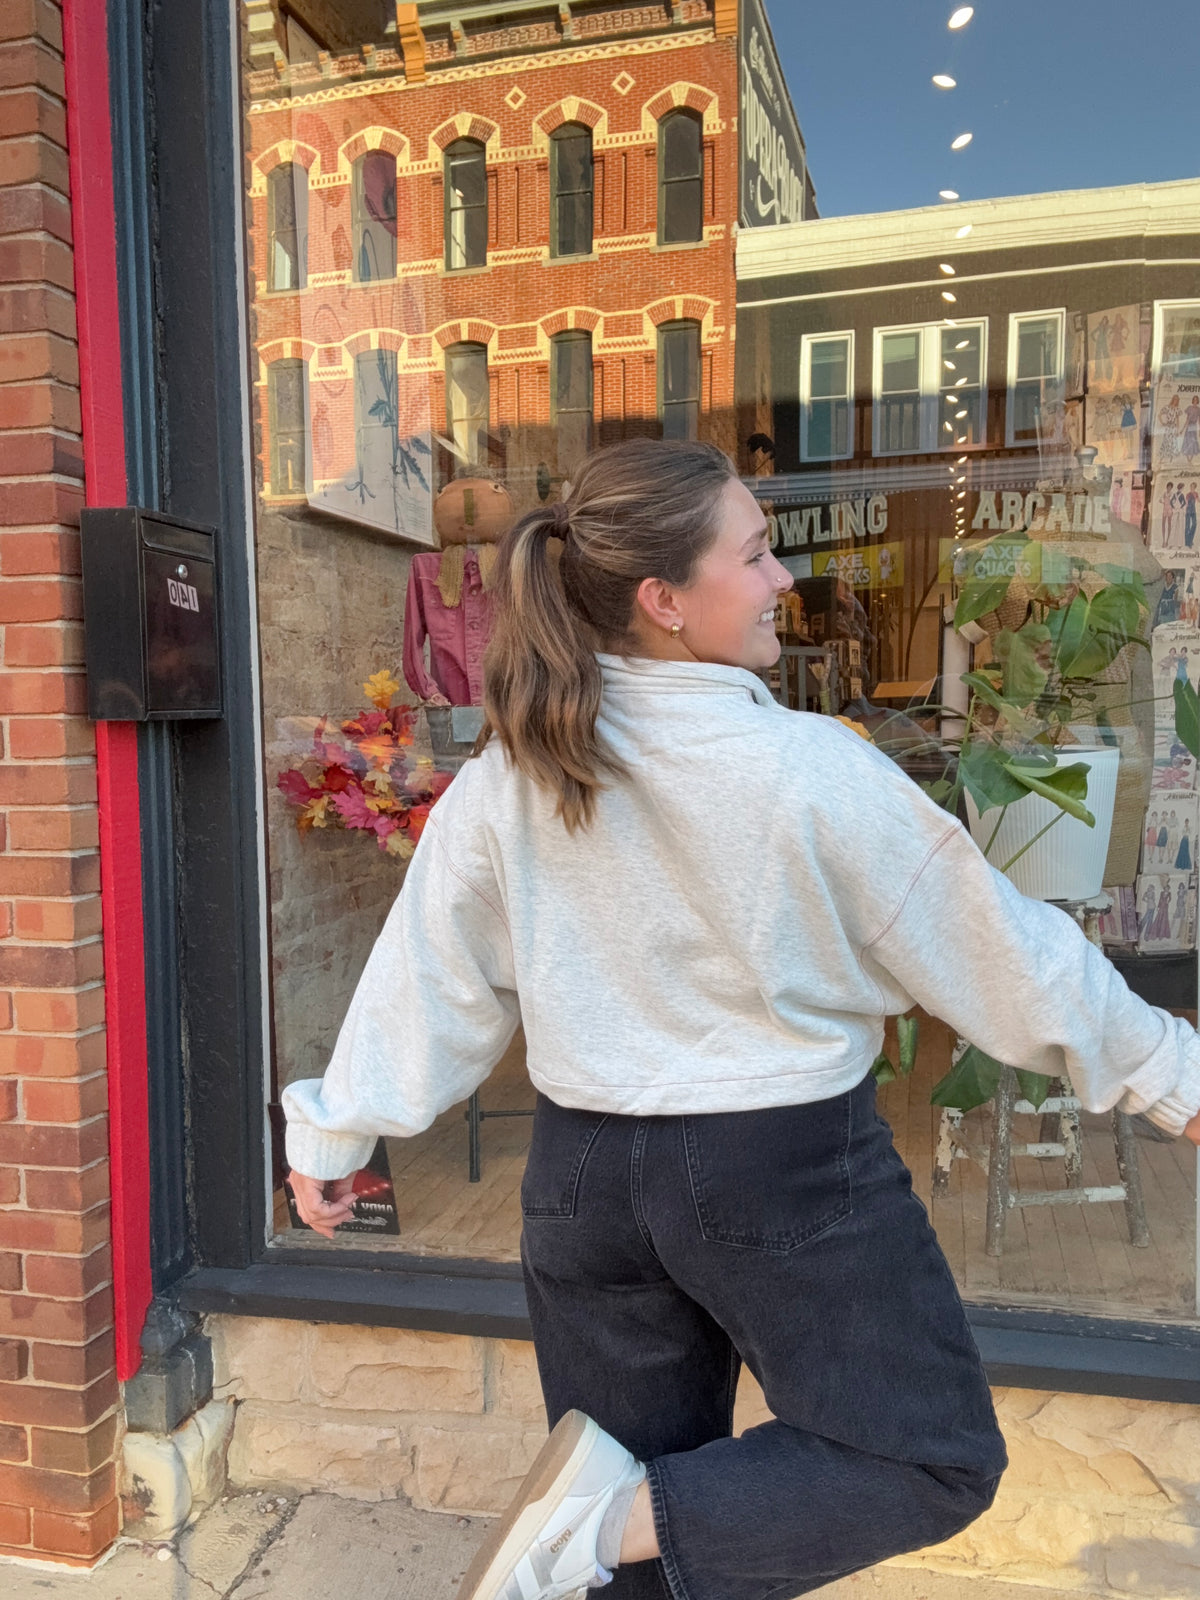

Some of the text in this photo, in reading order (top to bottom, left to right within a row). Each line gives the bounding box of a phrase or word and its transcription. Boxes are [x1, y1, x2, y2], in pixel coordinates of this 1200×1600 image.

[766, 494, 888, 549] OWLING
[972, 490, 1112, 533] ARCADE
[826, 553, 864, 570] AXE
[982, 545, 1024, 560] AXE
[974, 560, 1031, 580] QUACKS
